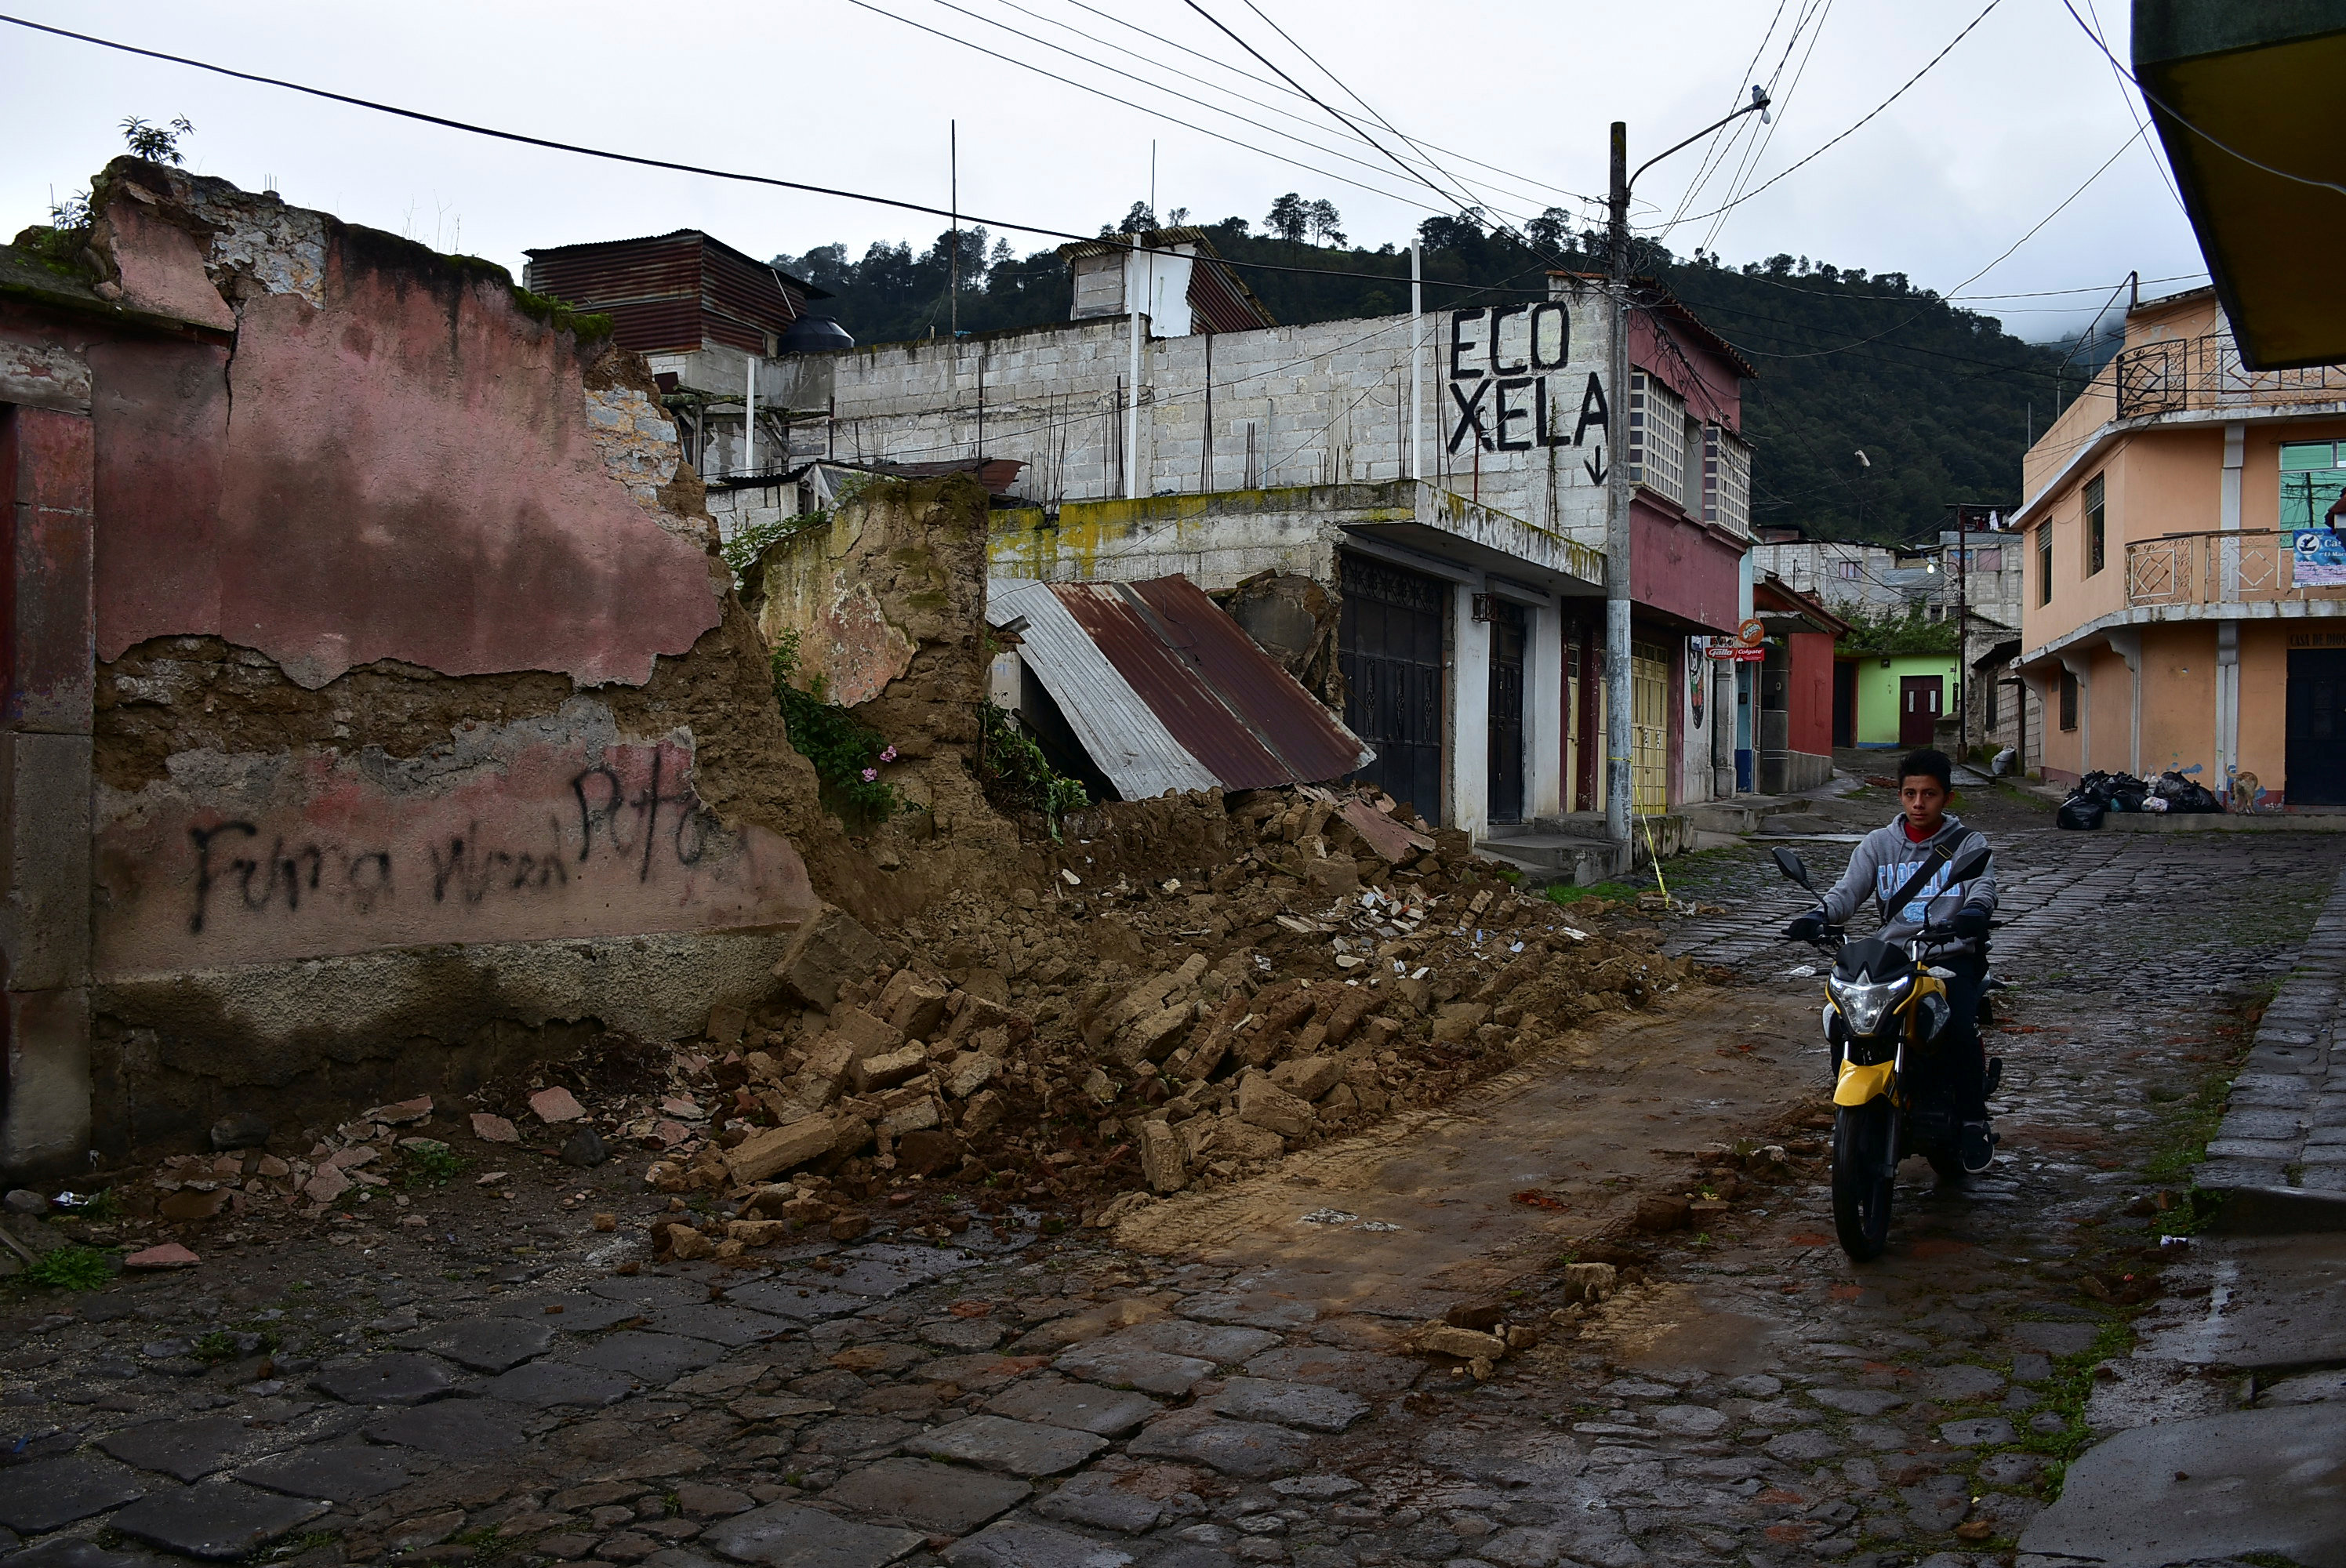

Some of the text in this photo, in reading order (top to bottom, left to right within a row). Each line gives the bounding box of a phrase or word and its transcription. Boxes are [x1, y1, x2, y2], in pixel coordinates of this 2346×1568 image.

[1451, 302, 1569, 379] ECO
[1448, 371, 1607, 455] XELA
[1708, 648, 1733, 657] Gallo
[2290, 633, 2309, 647] CASA
[2312, 633, 2323, 647] DE
